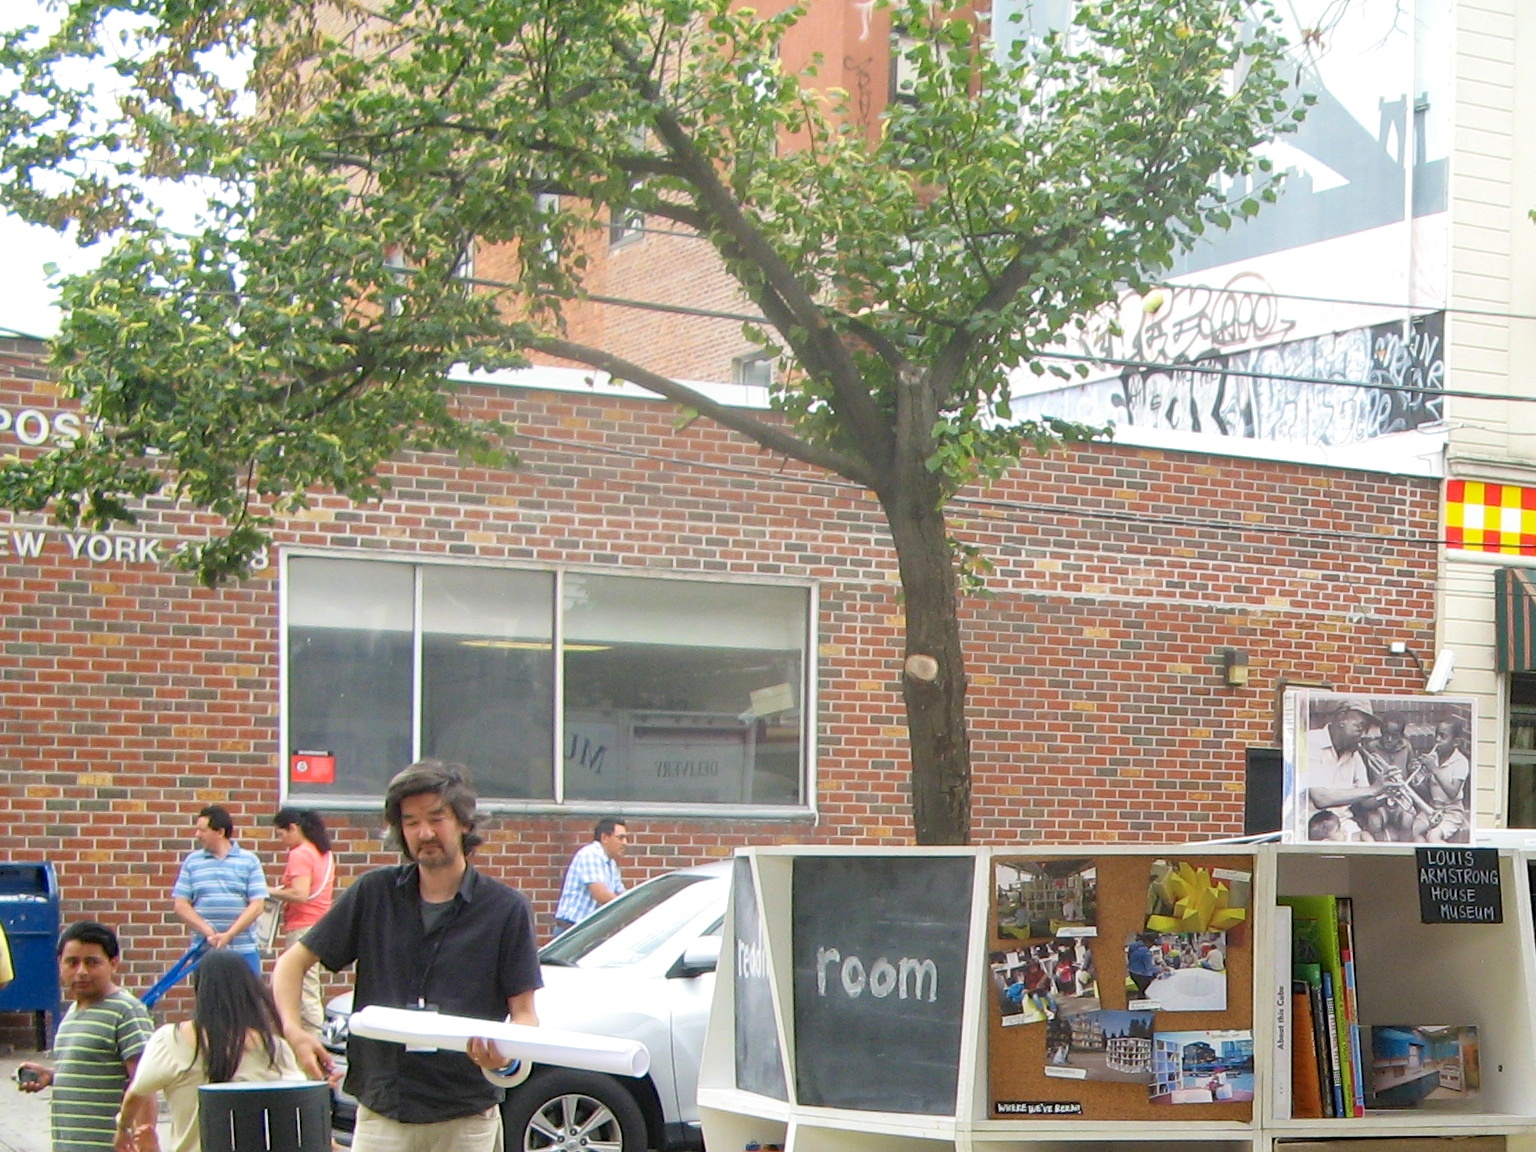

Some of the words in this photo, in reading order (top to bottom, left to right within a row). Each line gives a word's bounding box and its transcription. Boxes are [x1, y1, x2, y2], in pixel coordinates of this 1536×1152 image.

[63, 533, 161, 564] YORK
[1427, 850, 1474, 867] LOUIS
[1420, 868, 1499, 886] ARMSTRONG
[1431, 887, 1476, 903] HOUSE
[1440, 904, 1495, 921] MUSEUM
[816, 945, 937, 1003] room
[1277, 985, 1285, 1003] Cube
[1277, 1005, 1285, 1020] this
[1277, 1022, 1285, 1050] About
[997, 1103, 1027, 1113] WHERE
